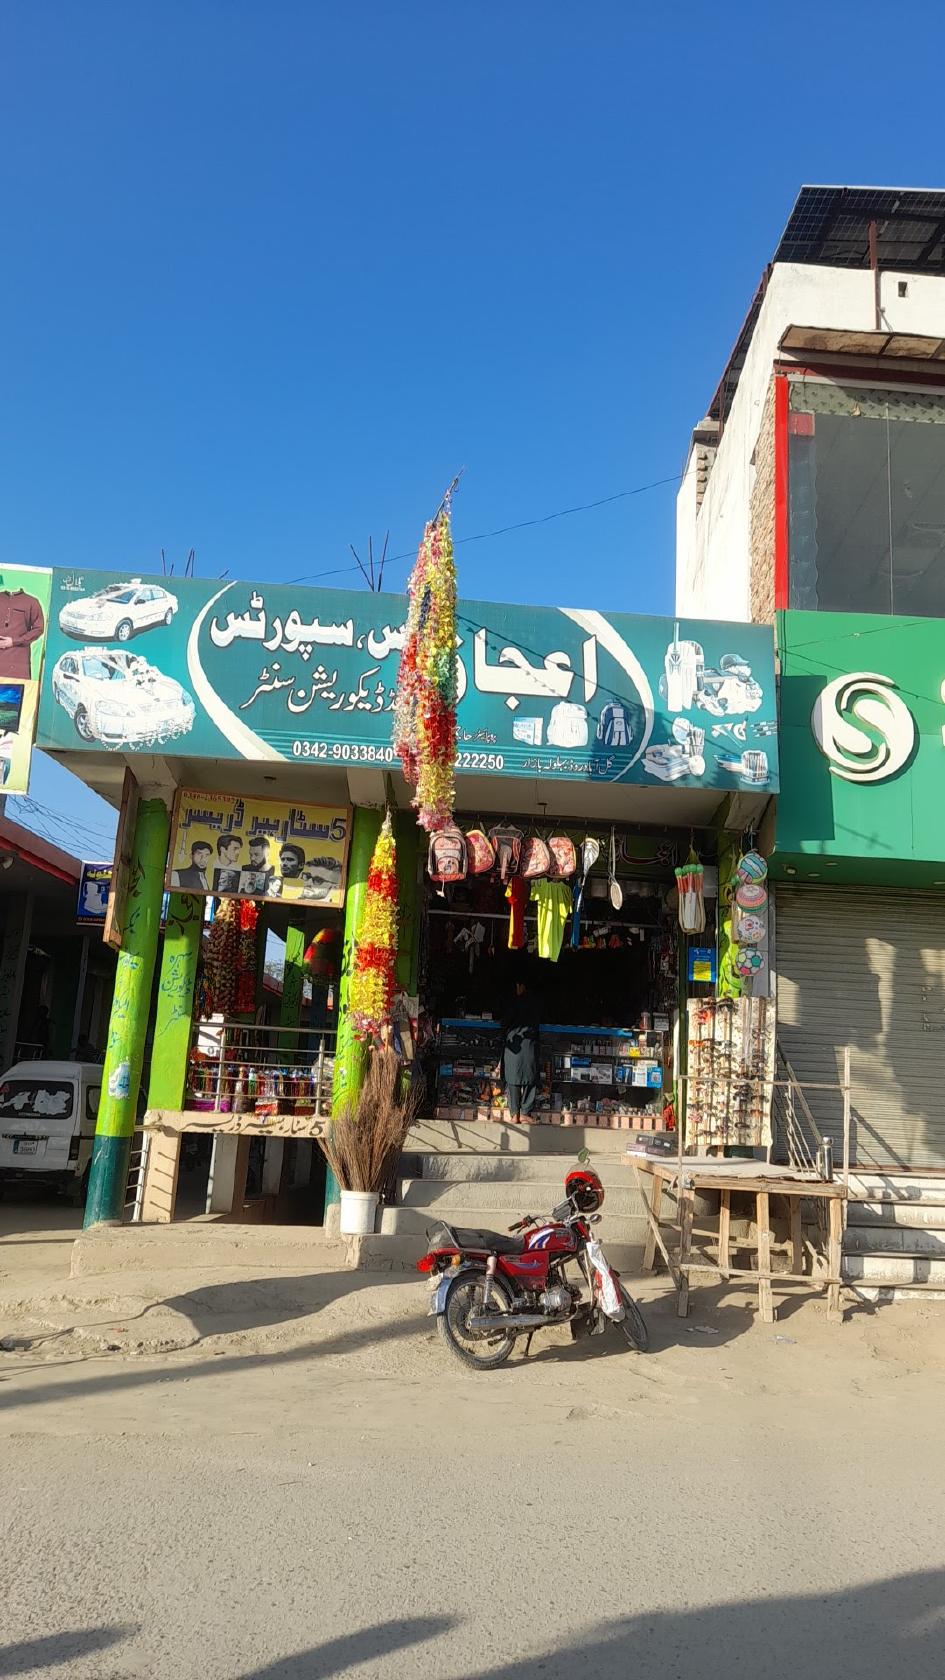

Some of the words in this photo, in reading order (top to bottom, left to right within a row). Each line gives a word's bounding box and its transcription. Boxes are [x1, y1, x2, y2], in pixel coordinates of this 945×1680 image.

[210, 590, 354, 662] سپورٹس
[239, 662, 296, 710] سنٹر
[292, 740, 394, 763] 0342-9033840
[454, 752, 504, 770] 222250
[329, 817, 347, 841] 5
[309, 1120, 327, 1137] 5
